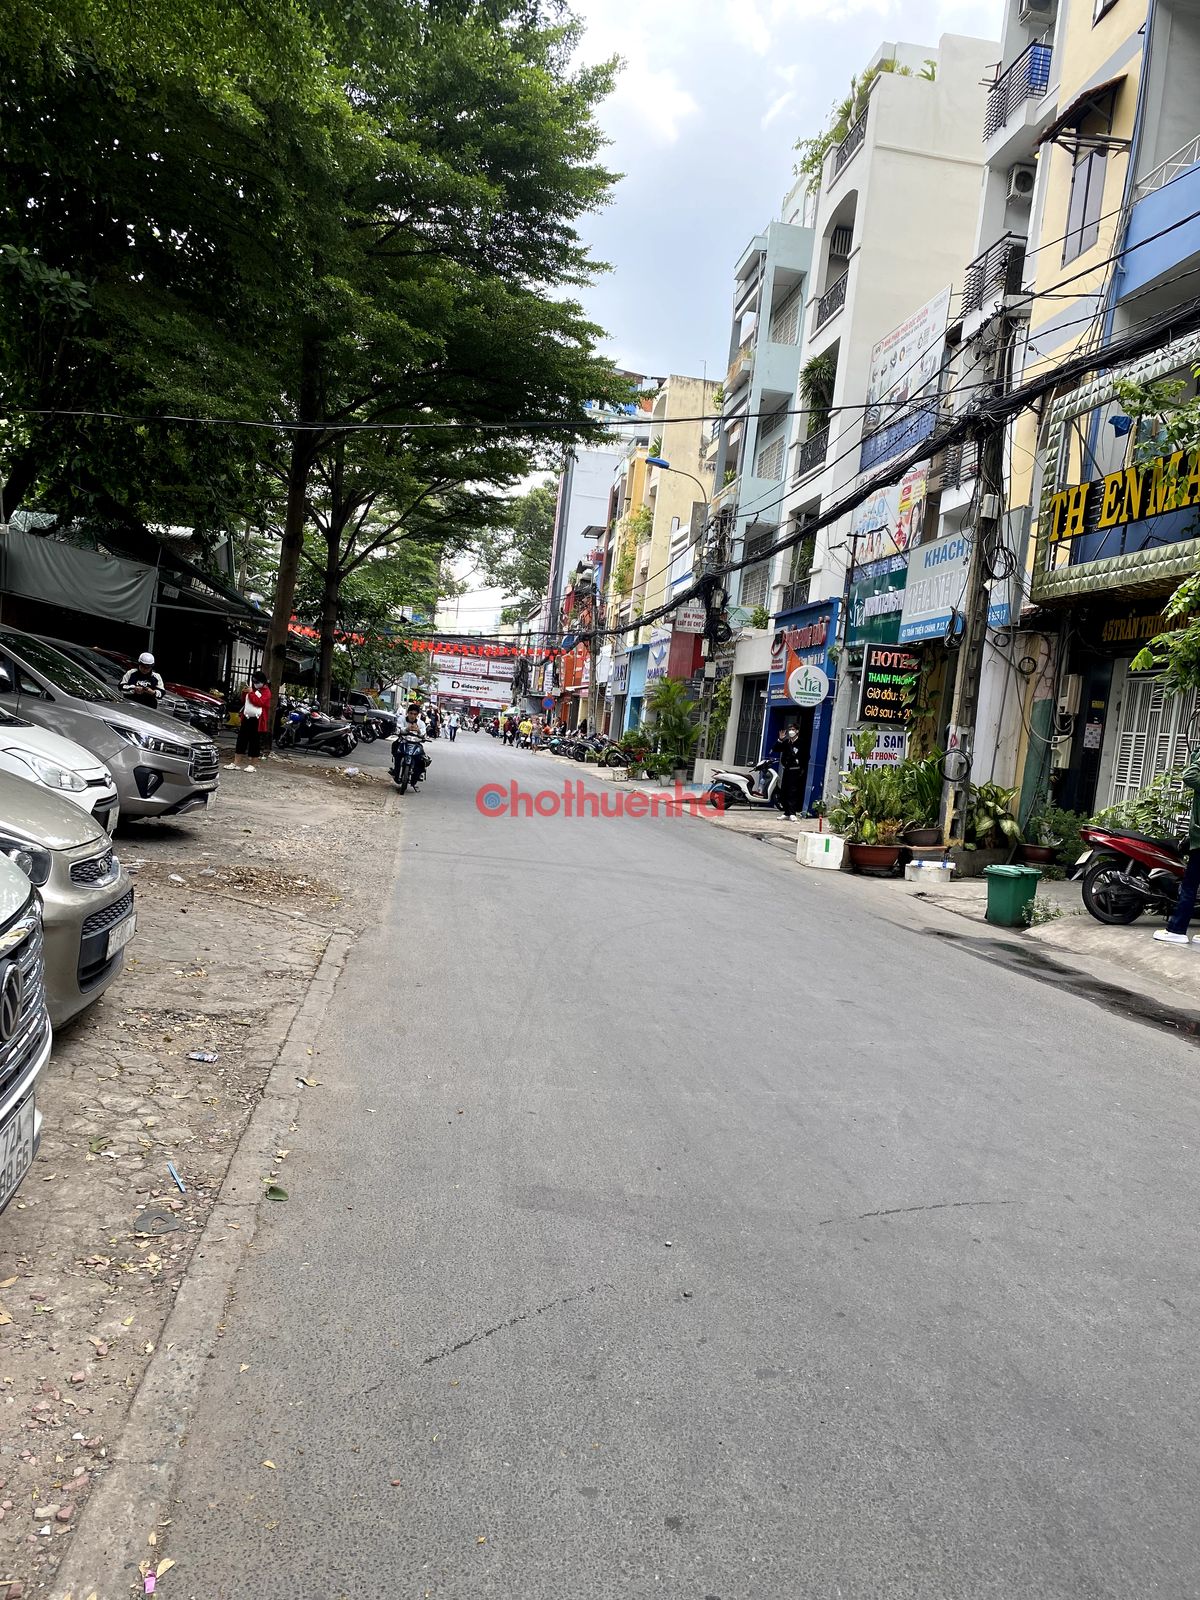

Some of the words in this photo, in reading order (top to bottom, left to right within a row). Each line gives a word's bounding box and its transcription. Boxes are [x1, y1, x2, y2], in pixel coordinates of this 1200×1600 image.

[924, 540, 965, 568] KHÁCH
[868, 672, 892, 684] THANH
[866, 687, 881, 699] Giờ
[864, 704, 879, 717] Giờ
[883, 735, 904, 751] SẠN
[875, 751, 898, 761] PHONG
[2, 1114, 22, 1163] 72A
